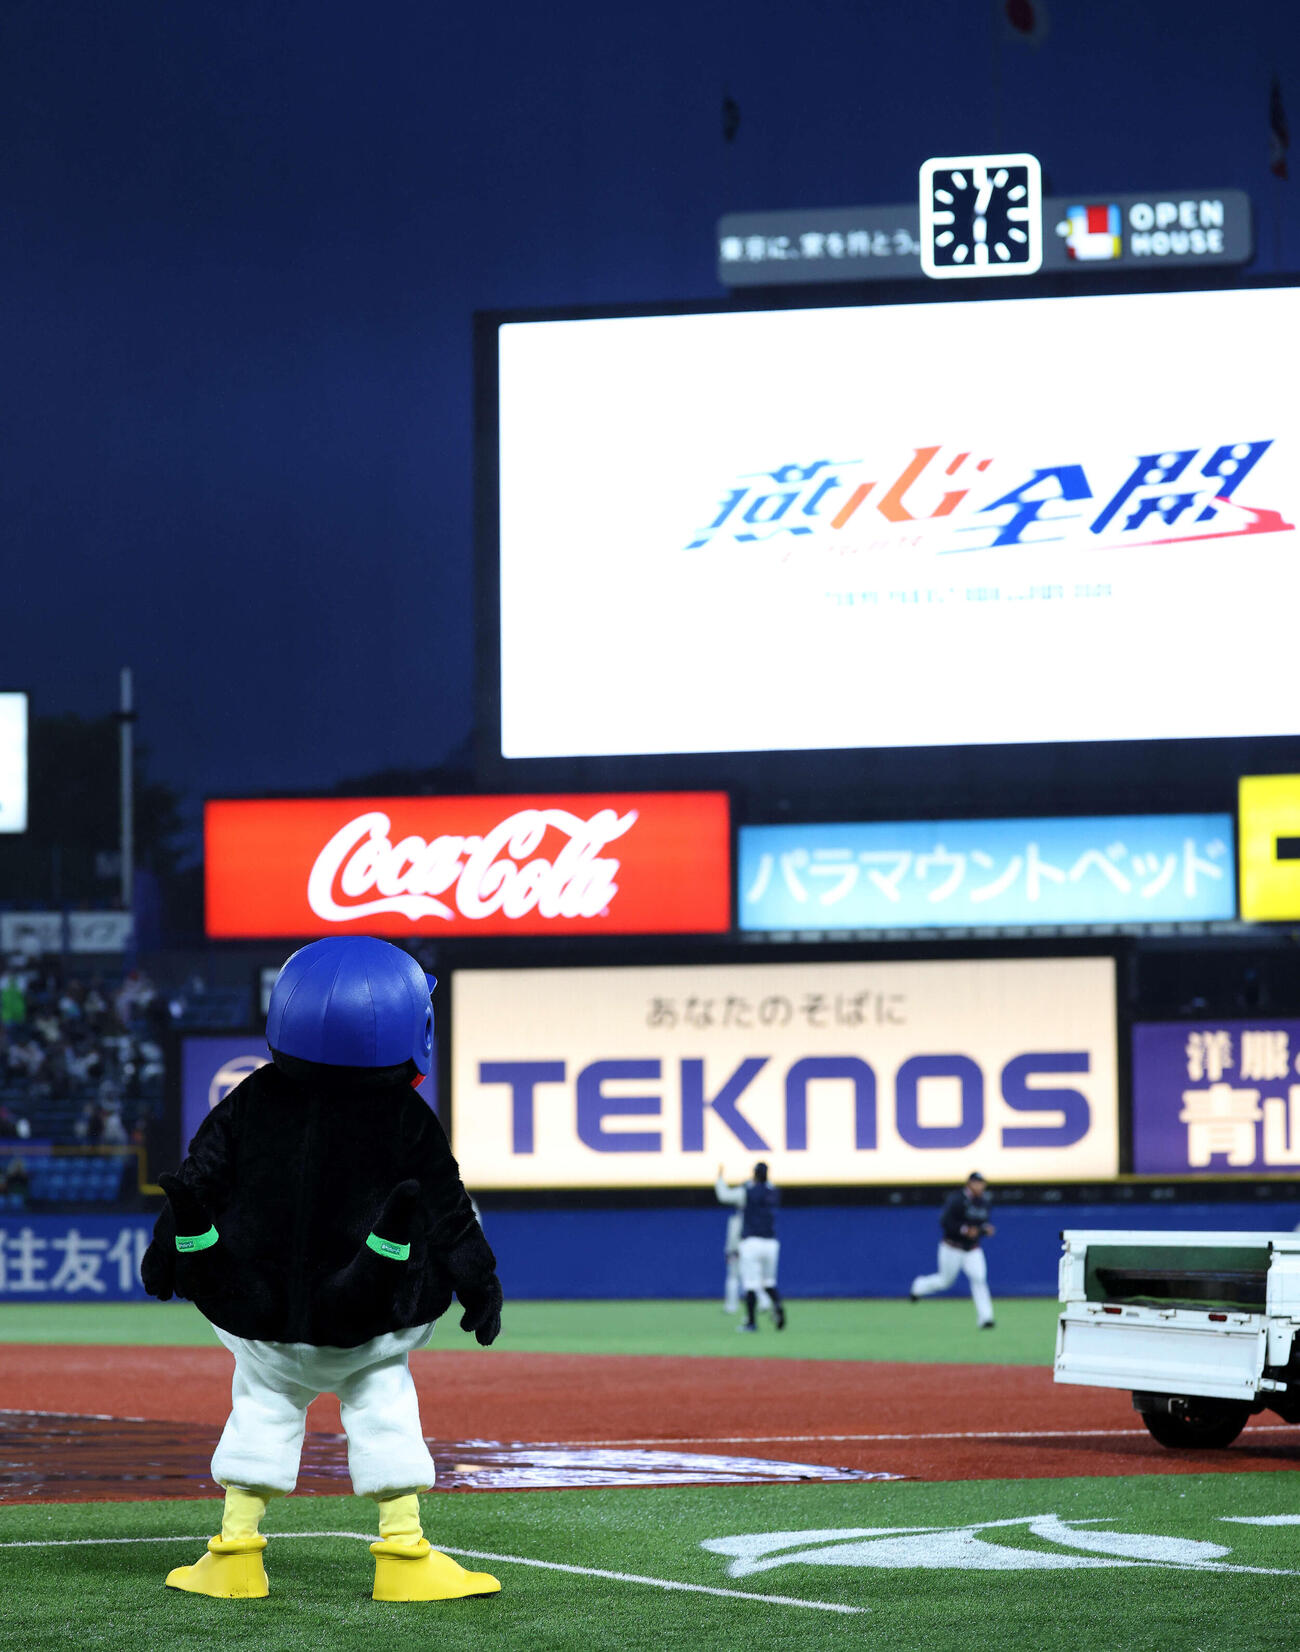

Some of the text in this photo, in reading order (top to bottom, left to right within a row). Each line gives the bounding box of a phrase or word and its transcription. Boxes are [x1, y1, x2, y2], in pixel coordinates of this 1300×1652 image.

[1129, 200, 1224, 231] OPEN
[1130, 229, 1224, 256] HOUSE
[307, 809, 639, 922] Coca-Cola
[746, 837, 1227, 905] パラマウントベッド
[646, 989, 907, 1030] あなたのそばに
[1186, 1030, 1300, 1081] 洋服
[478, 1051, 1092, 1155] TEKNOS
